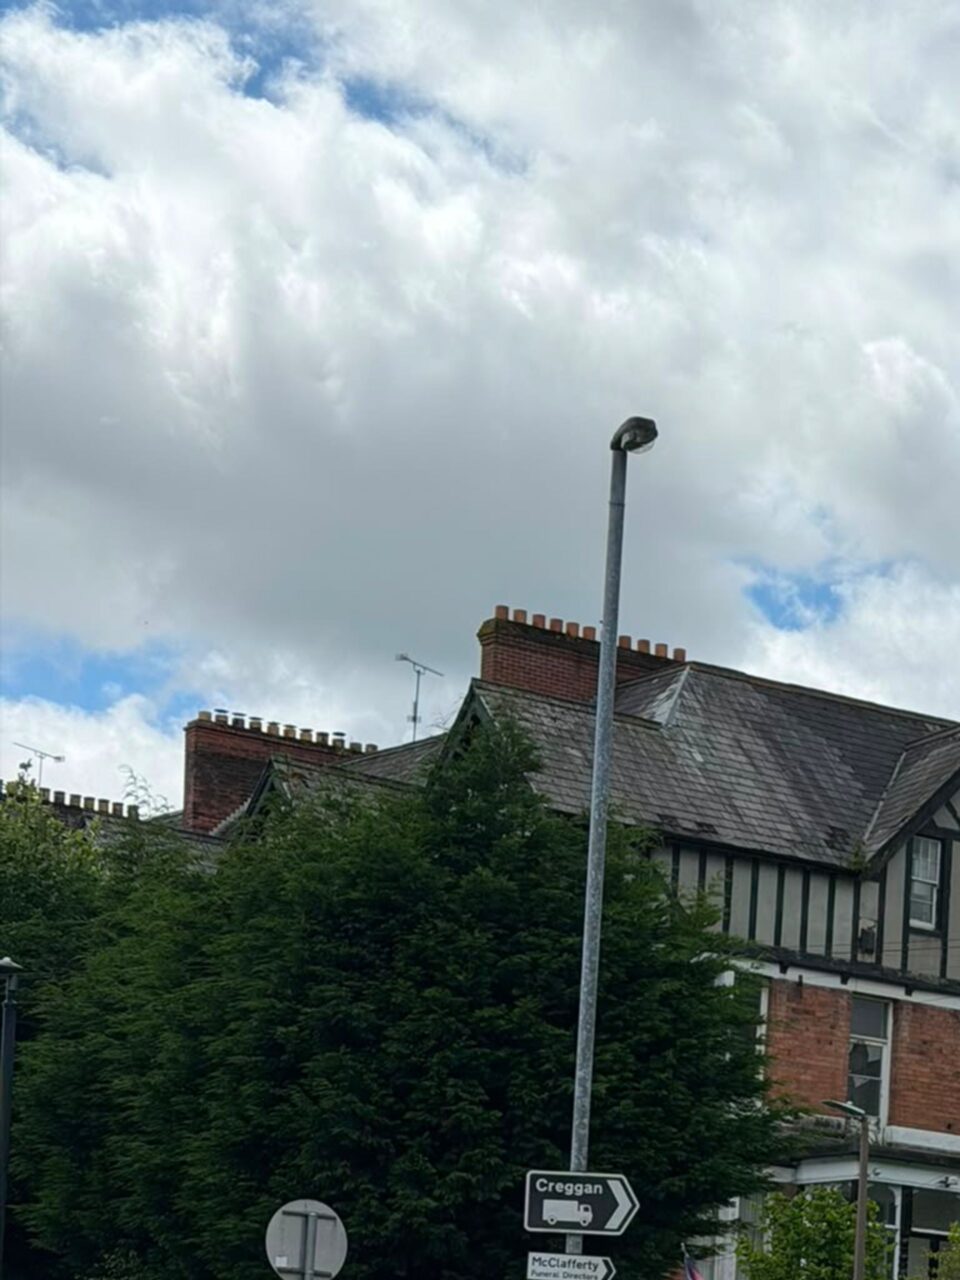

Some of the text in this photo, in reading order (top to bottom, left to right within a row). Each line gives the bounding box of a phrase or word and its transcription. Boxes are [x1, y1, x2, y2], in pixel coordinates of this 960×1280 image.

[535, 1178, 603, 1196] Creggan
[531, 1256, 599, 1273] McClafferty
[531, 1269, 599, 1280] Funeral Directors
